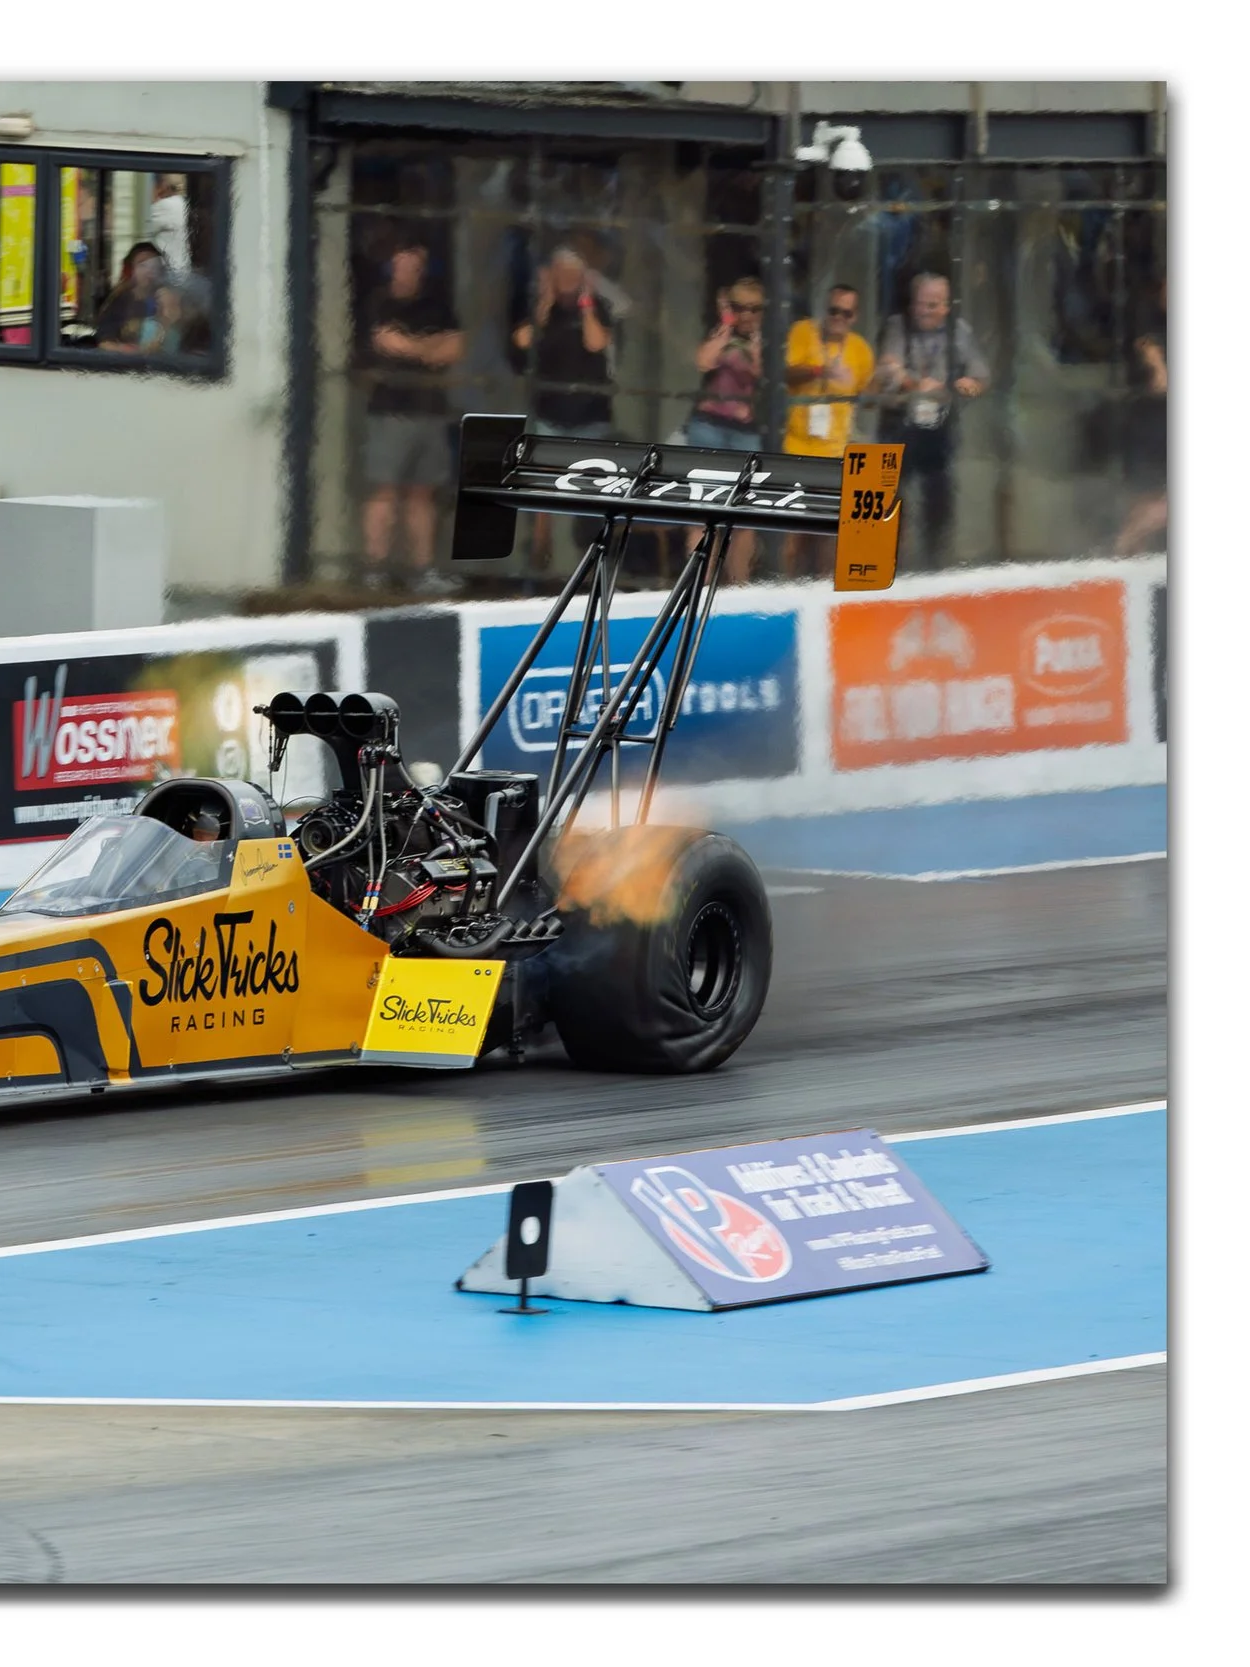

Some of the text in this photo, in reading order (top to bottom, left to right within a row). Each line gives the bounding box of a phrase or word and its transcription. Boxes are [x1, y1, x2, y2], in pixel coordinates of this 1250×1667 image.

[848, 453, 867, 475] TF
[851, 490, 885, 521] 393
[171, 1008, 265, 1033] RACING
[397, 1024, 456, 1035] RACING
